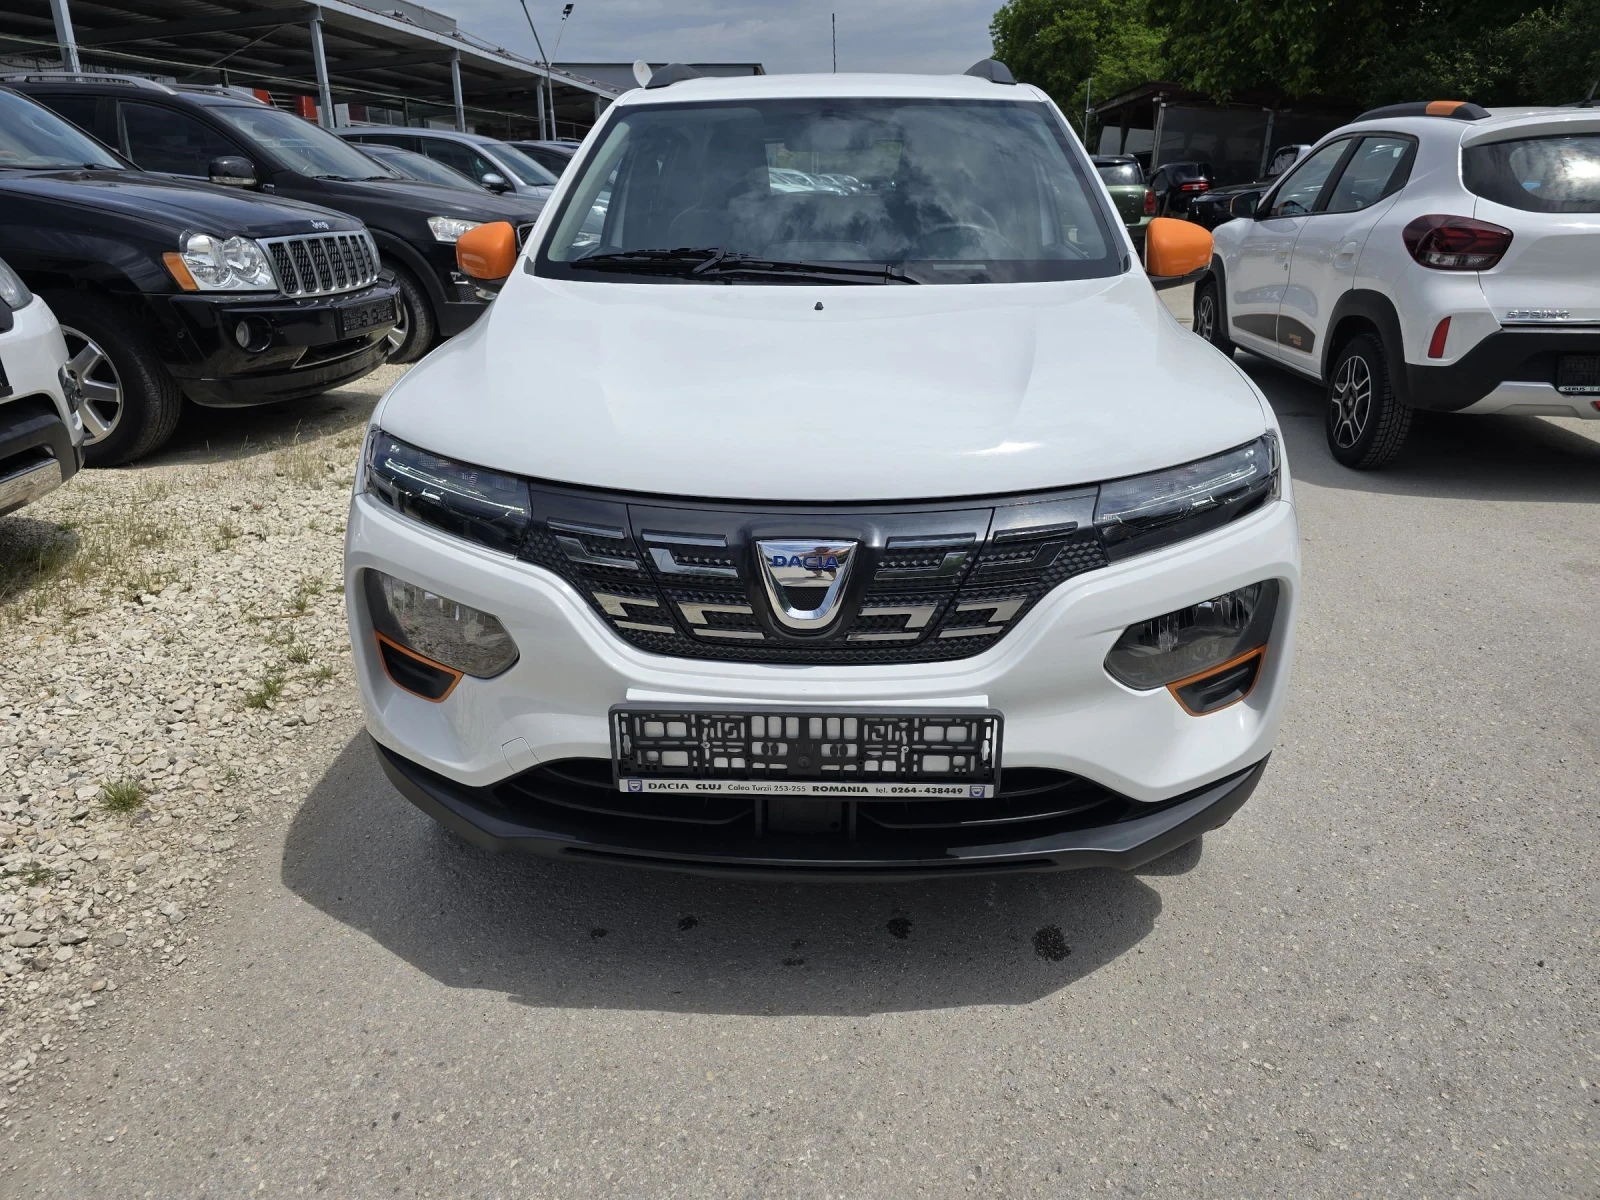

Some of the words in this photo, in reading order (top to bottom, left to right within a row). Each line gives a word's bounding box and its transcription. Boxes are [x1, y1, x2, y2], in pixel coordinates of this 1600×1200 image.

[1506, 309, 1570, 319] SPRING
[772, 555, 840, 569] DACIA
[648, 782, 690, 790] DACIA
[695, 783, 722, 791] CLUJ
[727, 783, 750, 791] Calea
[812, 785, 869, 793] ROMANIA
